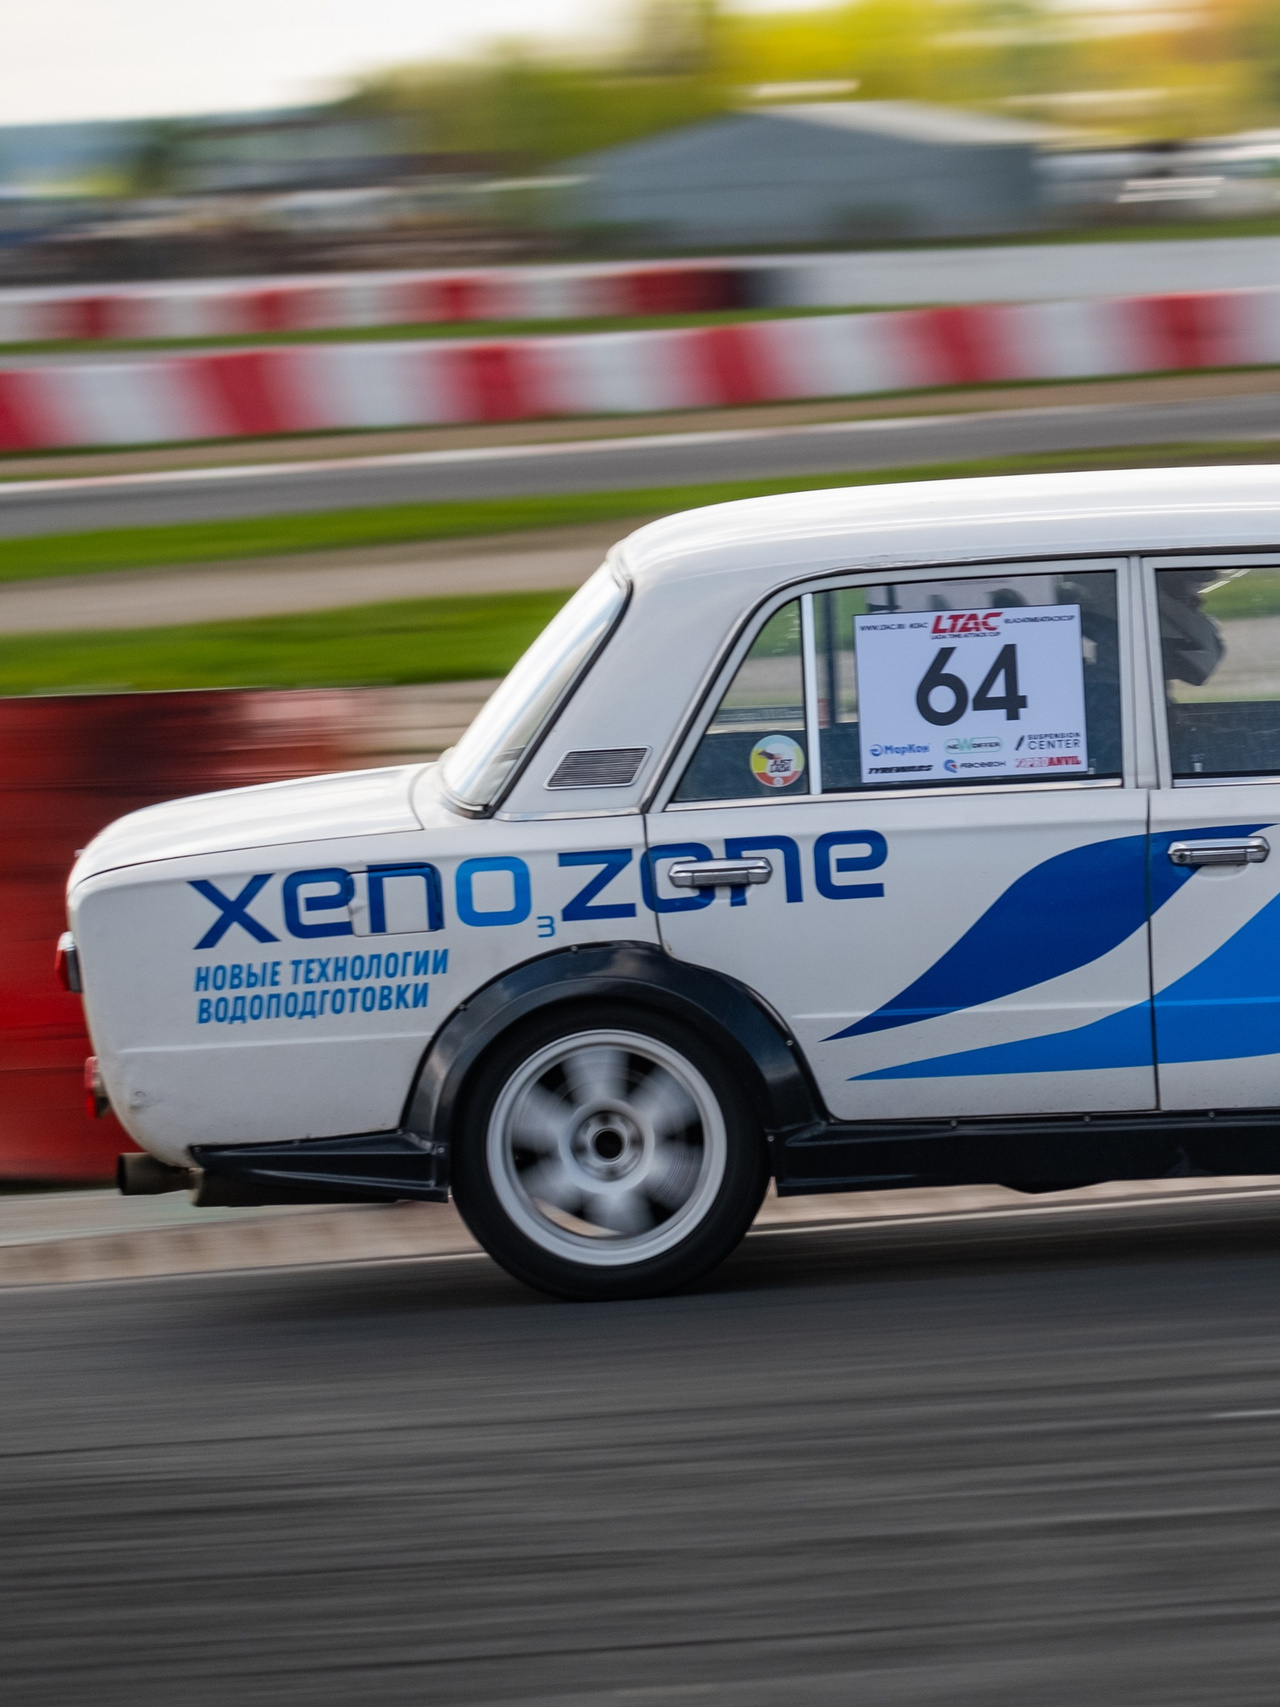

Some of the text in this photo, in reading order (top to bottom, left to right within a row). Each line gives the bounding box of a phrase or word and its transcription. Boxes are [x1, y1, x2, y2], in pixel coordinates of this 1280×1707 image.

[931, 611, 1003, 634] LTAC
[916, 643, 1028, 727] 64
[1028, 732, 1081, 740] SUSPENSION
[1028, 738, 1081, 750] CENTER
[194, 948, 449, 992] НОВЫЕ ТЕХНОЛОГИИ
[197, 981, 430, 1025] ВОДОПОДГОТОВКИ
